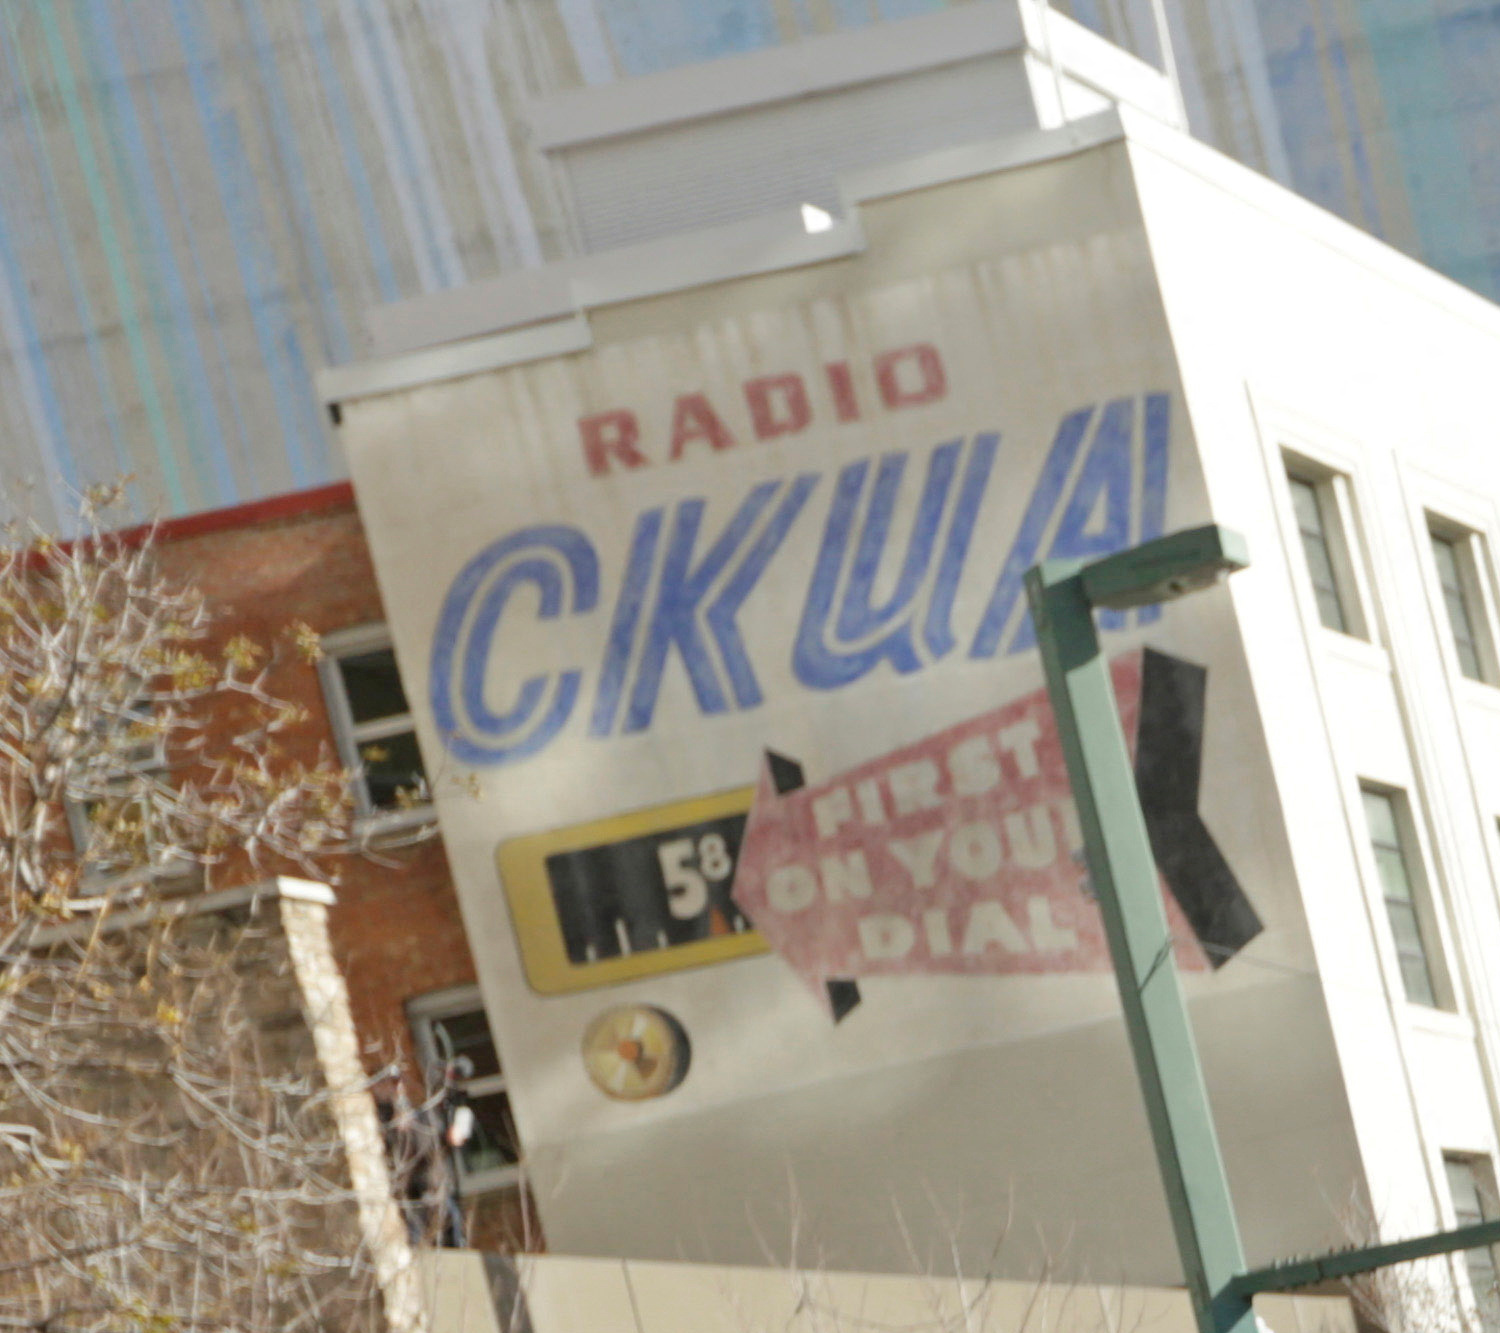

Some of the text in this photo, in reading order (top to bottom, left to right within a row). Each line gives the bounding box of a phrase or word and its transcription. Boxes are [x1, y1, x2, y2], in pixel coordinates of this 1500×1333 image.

[576, 341, 948, 478] RADIO
[428, 391, 1172, 769] CKUA
[812, 717, 1043, 840] FIRST
[764, 800, 1085, 915] ON YOU
[857, 895, 1078, 960] DIAL
